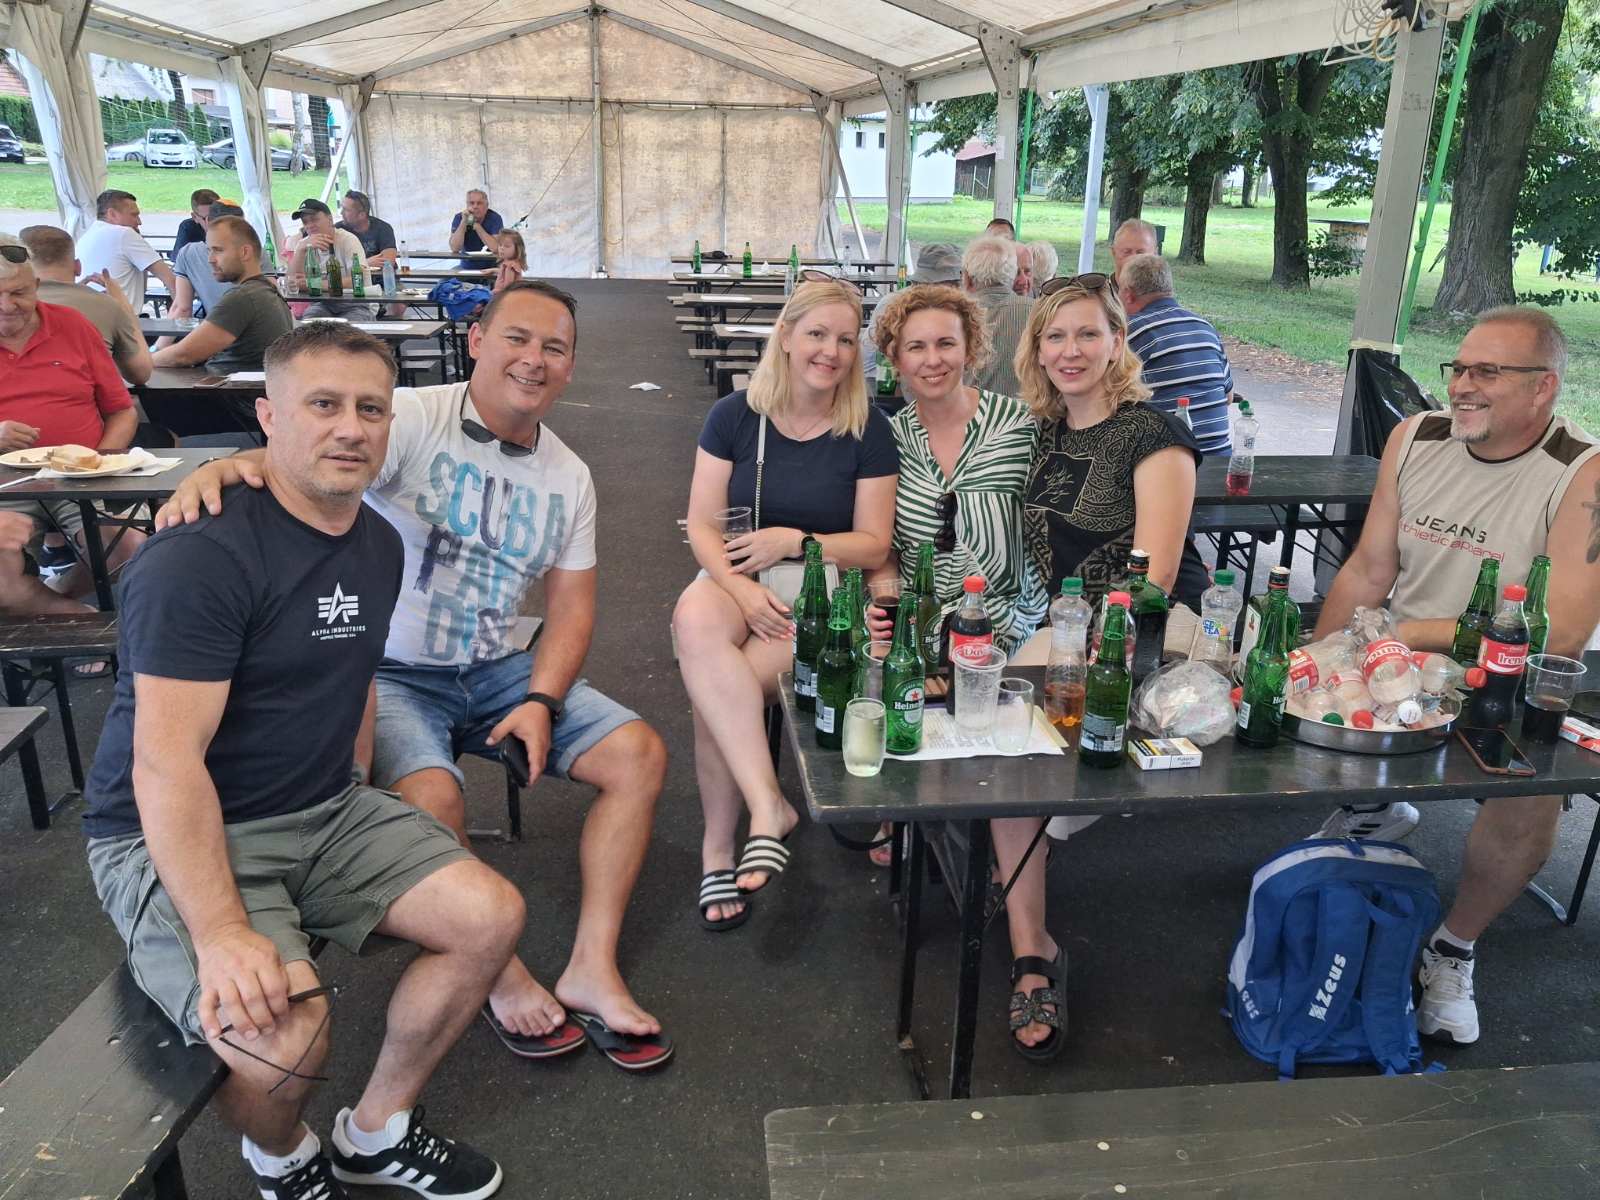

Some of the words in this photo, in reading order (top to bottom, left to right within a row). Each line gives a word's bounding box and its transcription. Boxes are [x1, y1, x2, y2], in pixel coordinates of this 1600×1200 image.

[415, 451, 566, 577] SCUBA
[1415, 515, 1487, 544] JEANS
[1315, 953, 1347, 1008] Zeus
